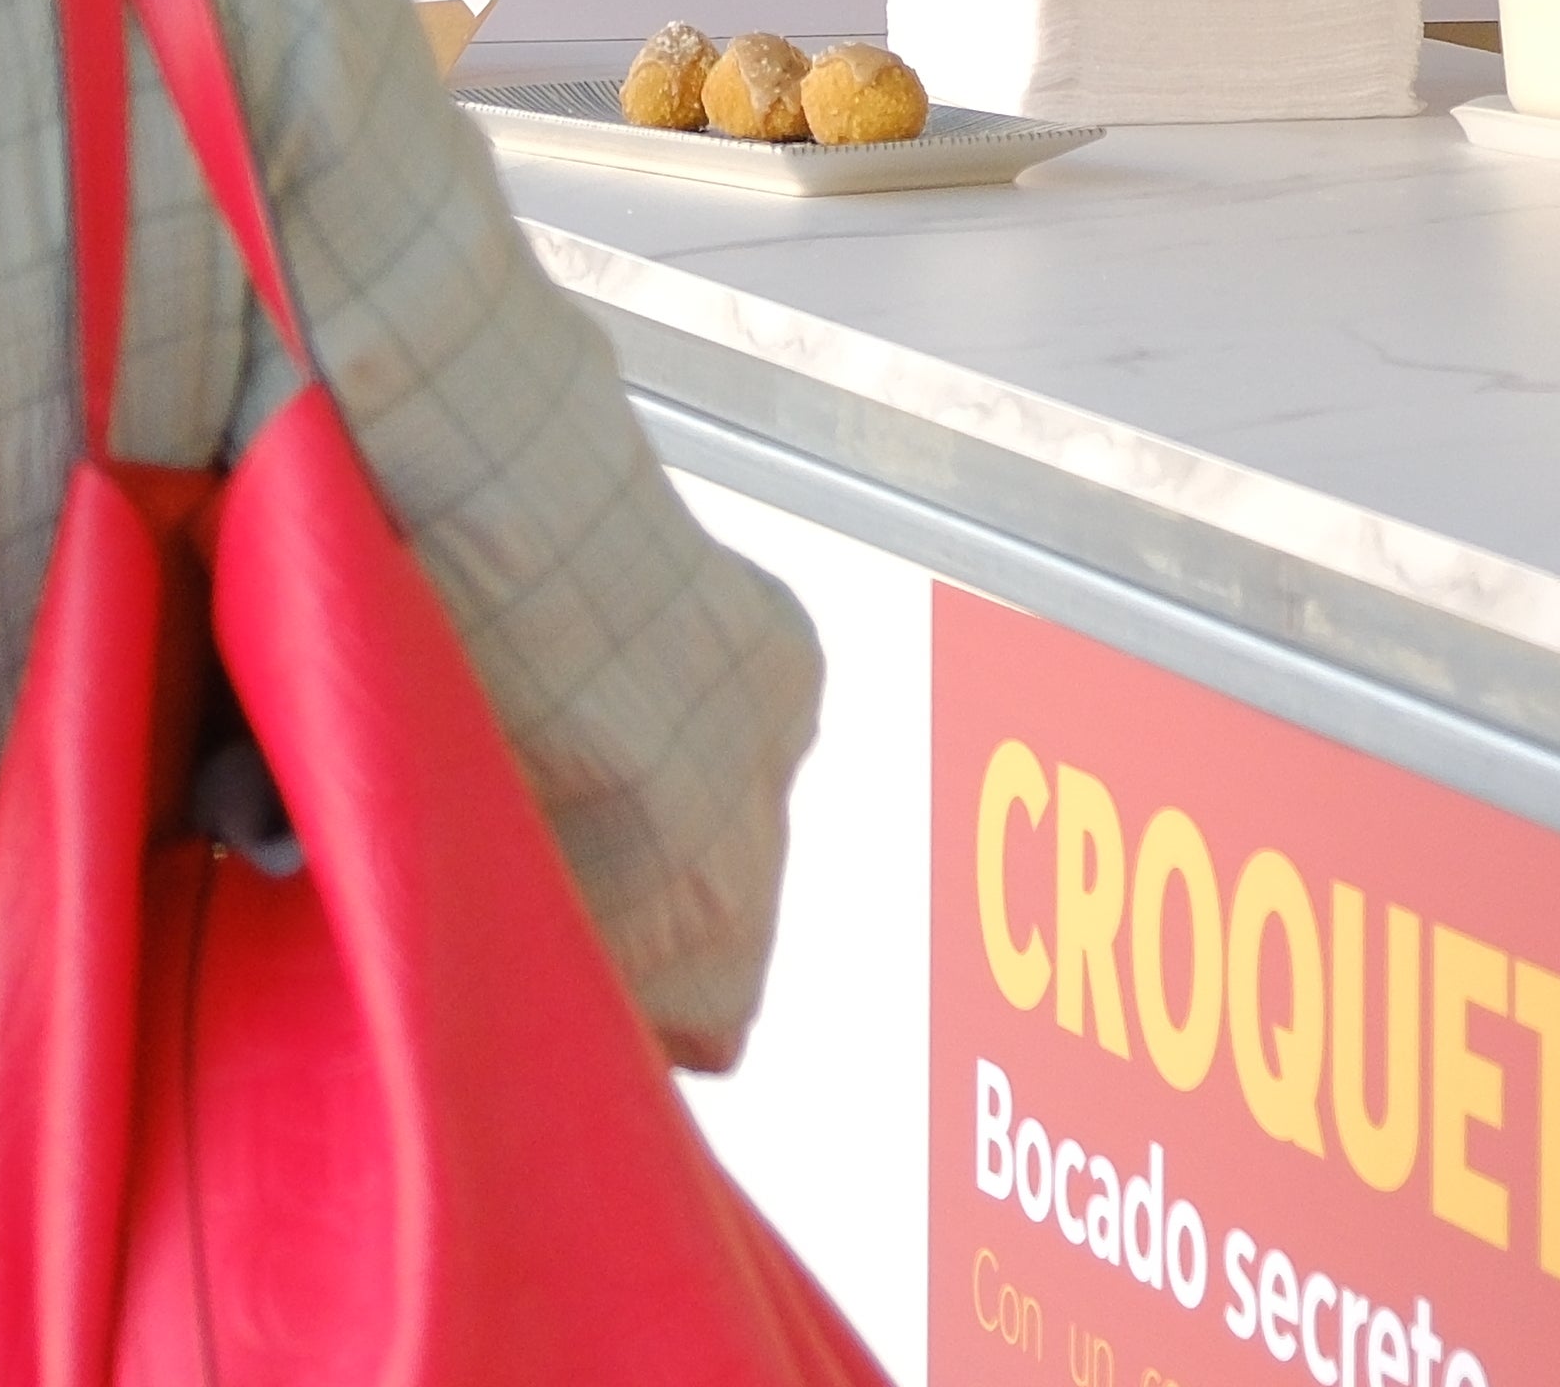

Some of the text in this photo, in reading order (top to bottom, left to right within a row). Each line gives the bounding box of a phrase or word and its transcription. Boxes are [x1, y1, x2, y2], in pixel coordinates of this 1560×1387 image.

[975, 1055, 1208, 1308] Bocado
[973, 1247, 1115, 1387] Con un
